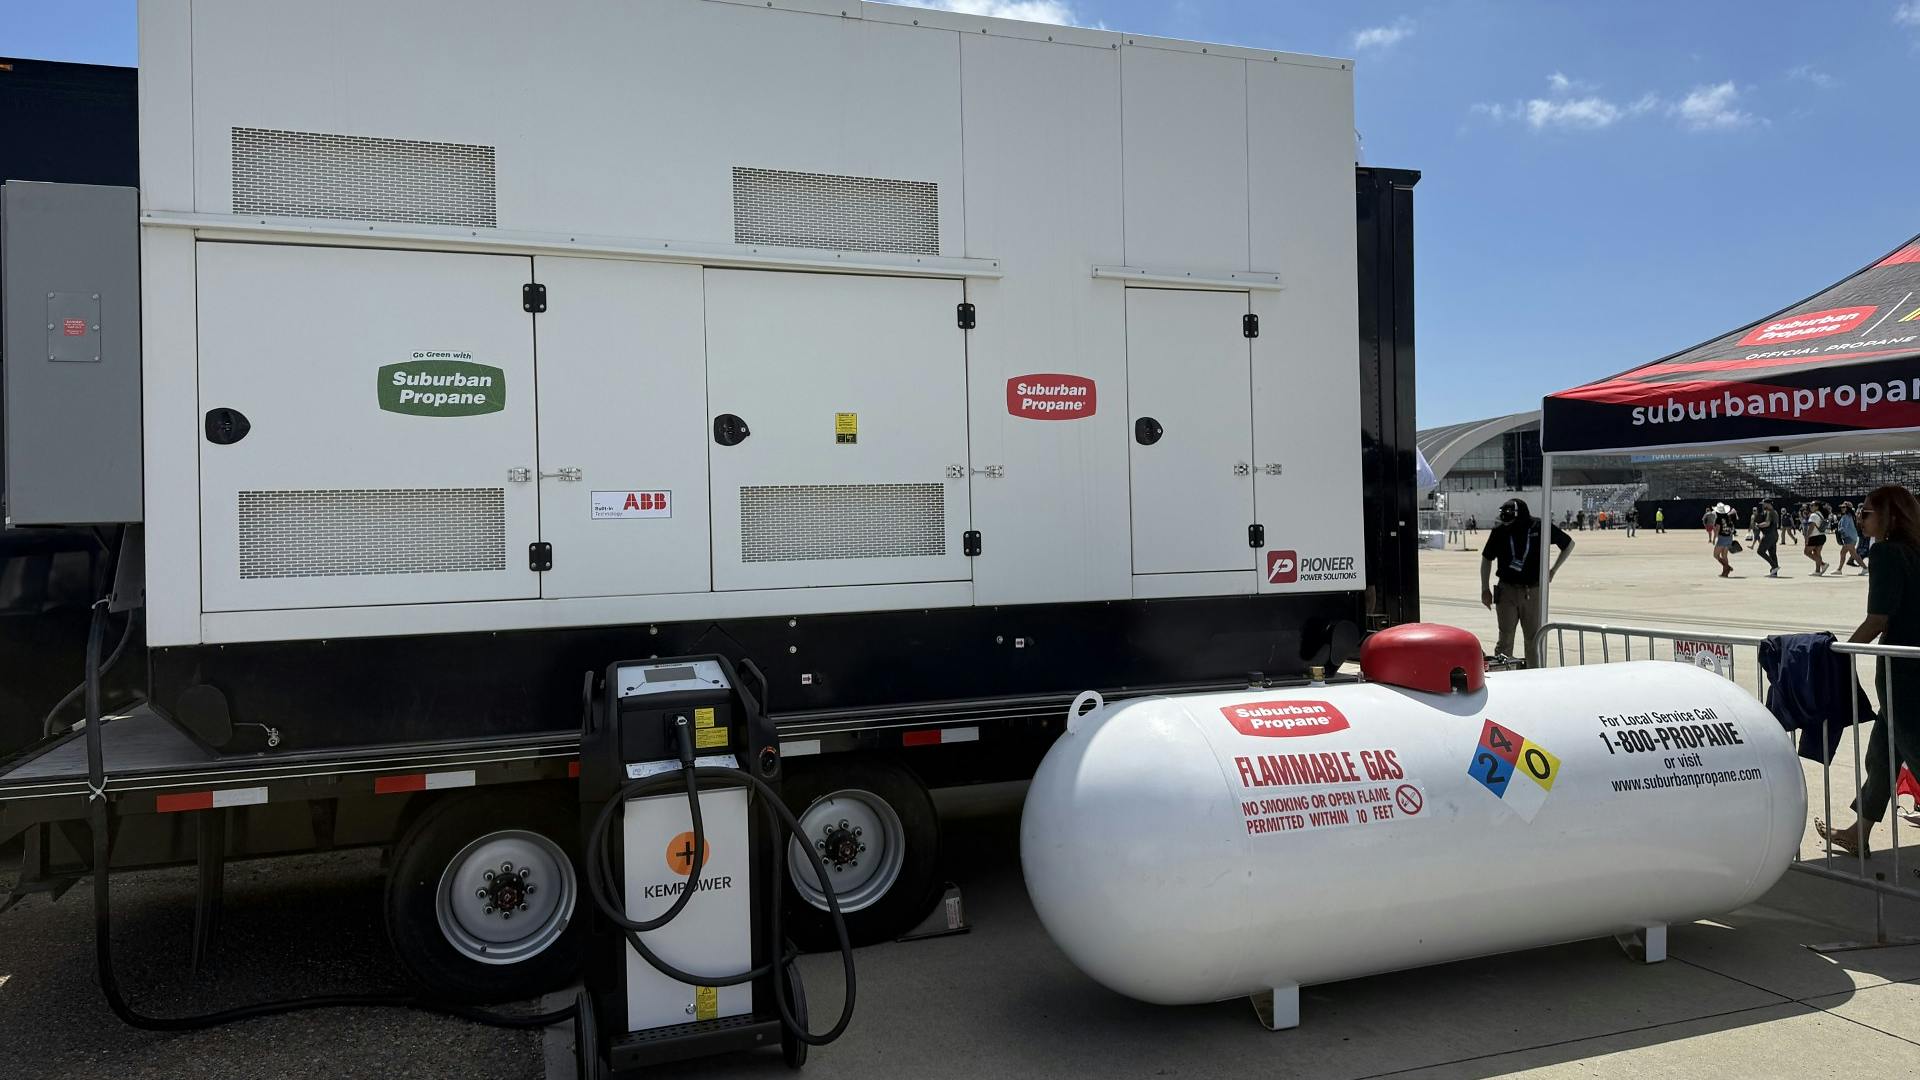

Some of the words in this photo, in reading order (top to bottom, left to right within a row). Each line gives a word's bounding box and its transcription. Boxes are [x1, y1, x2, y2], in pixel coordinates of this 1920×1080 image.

[1762, 312, 1860, 332] Suburban
[1756, 324, 1842, 341] Propane
[453, 351, 472, 359] with
[1745, 346, 1819, 360] OFFICIAL
[1825, 335, 1917, 351] PROPANE
[392, 371, 492, 387] Suburban
[399, 389, 486, 407] Propane
[1016, 383, 1087, 396] Suburban
[1021, 398, 1083, 412] Propane
[623, 493, 667, 510] ABB
[1300, 557, 1354, 572] PIONEER
[1300, 573, 1322, 581] POWER
[1323, 572, 1357, 580] SOLUTIONS
[1676, 641, 1729, 657] NATIONAL
[1237, 704, 1326, 718] Suburban
[1599, 715, 1620, 728] For
[1623, 711, 1652, 726] Local
[1655, 709, 1694, 724] Service
[1696, 707, 1718, 721] Call
[1252, 716, 1330, 730] Propane
[1490, 726, 1513, 753] 4
[1599, 722, 1744, 754] 1-800-PROPANE
[1234, 752, 1361, 788] FLAMMABLE
[1360, 749, 1404, 781] GAS
[1478, 754, 1505, 784] 2
[1524, 748, 1551, 780] 0
[1664, 756, 1677, 769] or
[1679, 753, 1703, 769] visit
[1611, 766, 1762, 793] www.suburbanpropane.com
[1242, 801, 1259, 816] NO
[1261, 796, 1310, 814] SMOKING
[1311, 794, 1328, 809] OR
[1329, 791, 1357, 807] OPEN
[1357, 787, 1391, 804] FLAME
[1246, 815, 1304, 834] PERMITTED
[1310, 810, 1349, 827] WITHIN
[1355, 809, 1368, 824] 10
[1374, 805, 1395, 820] FEET
